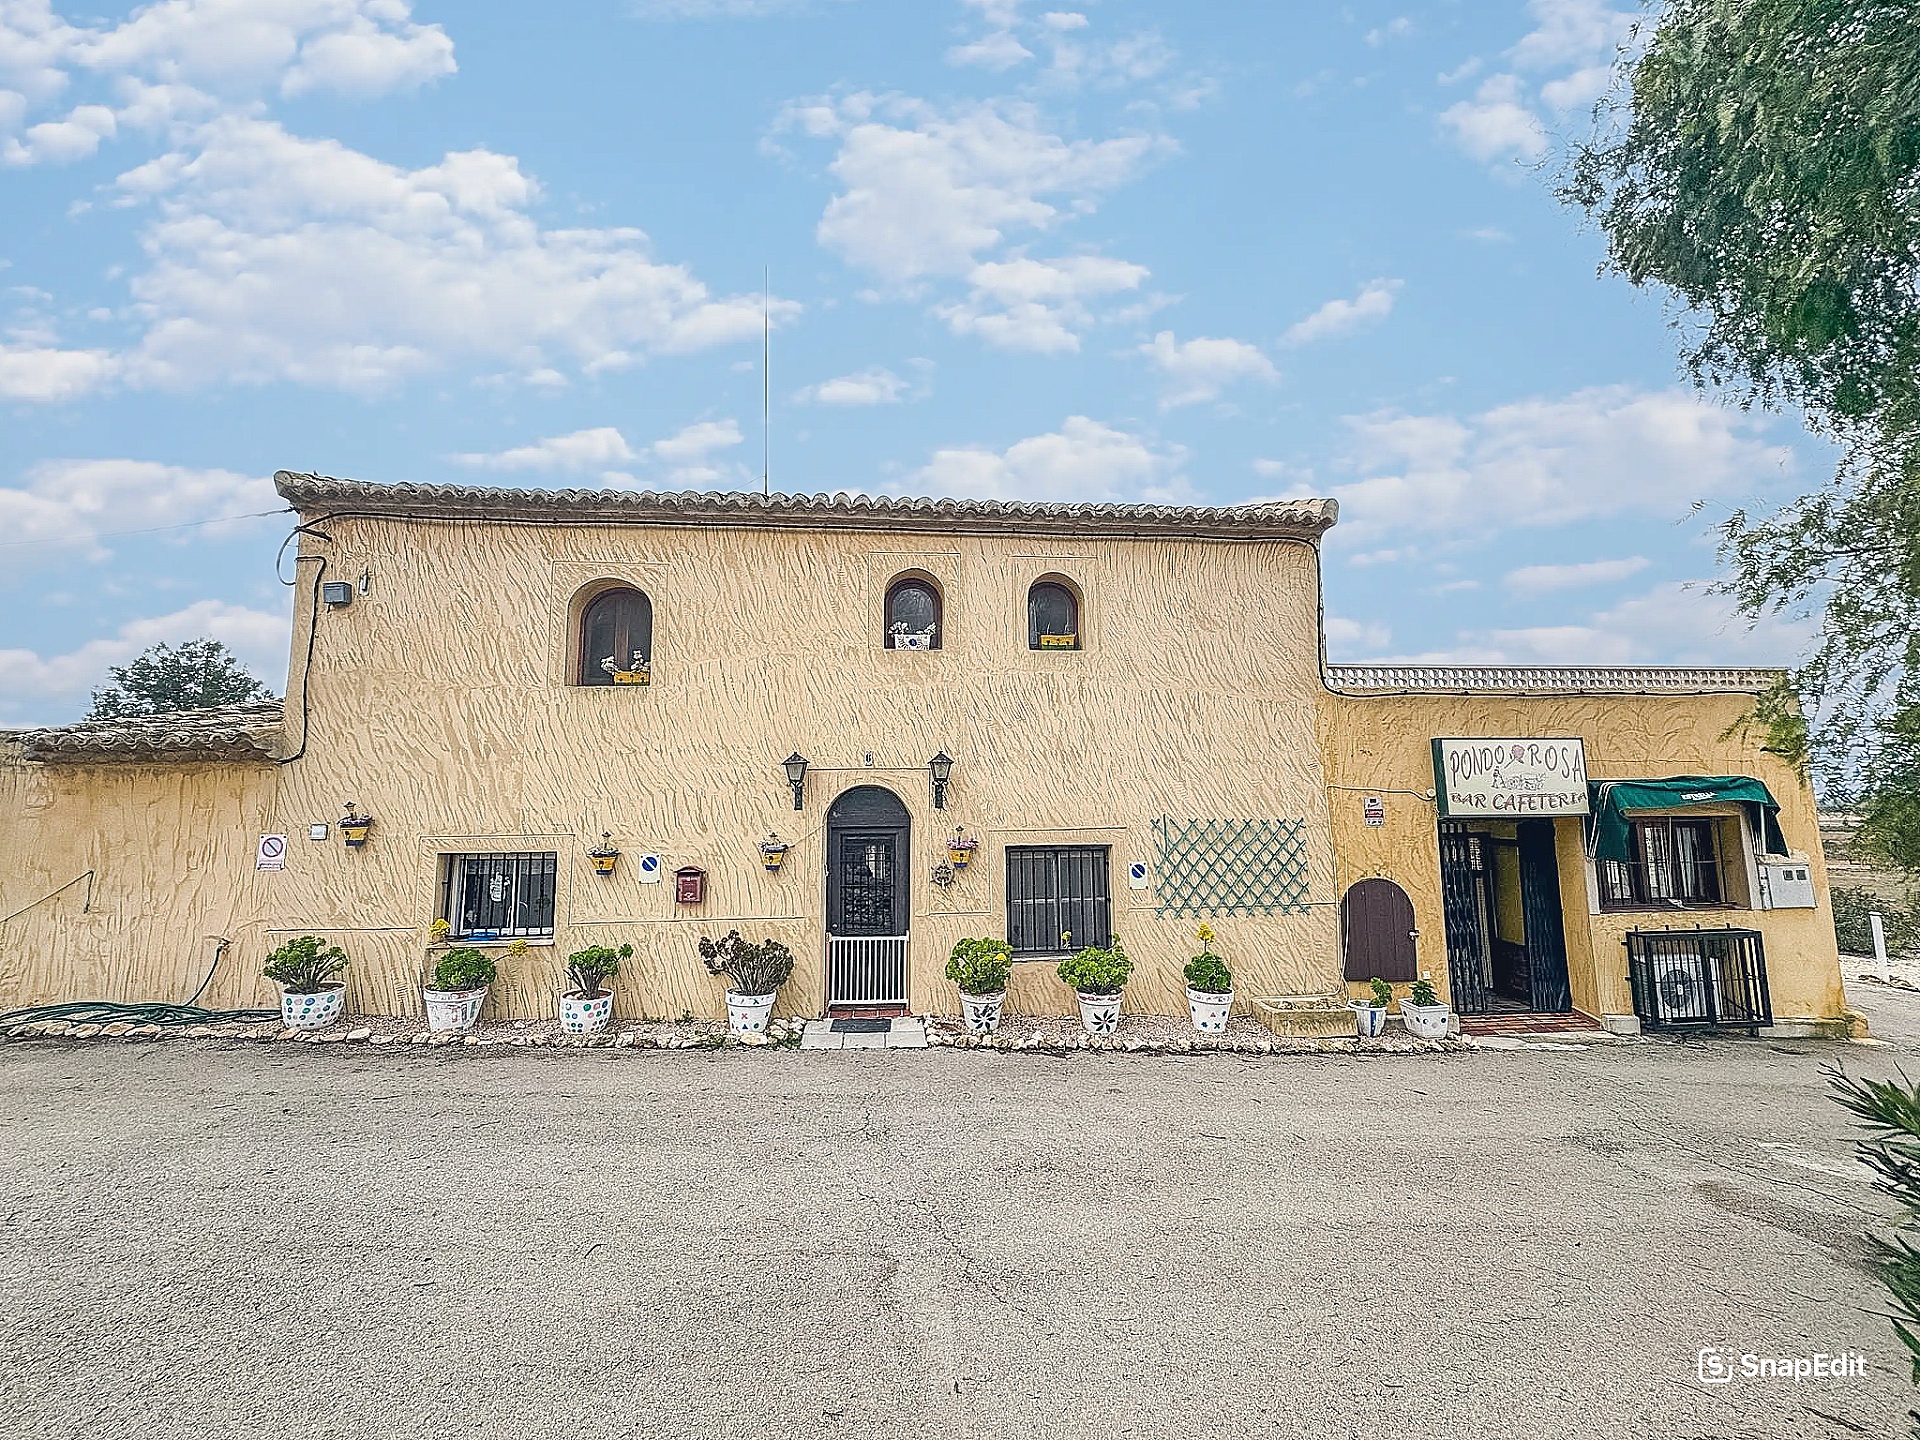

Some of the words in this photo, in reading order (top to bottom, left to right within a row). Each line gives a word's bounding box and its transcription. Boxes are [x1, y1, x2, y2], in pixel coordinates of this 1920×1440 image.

[1450, 744, 1505, 787] PONDO
[1527, 743, 1584, 782] ROSA
[1450, 792, 1487, 808] BAR
[1492, 792, 1587, 812] CAFETERIA
